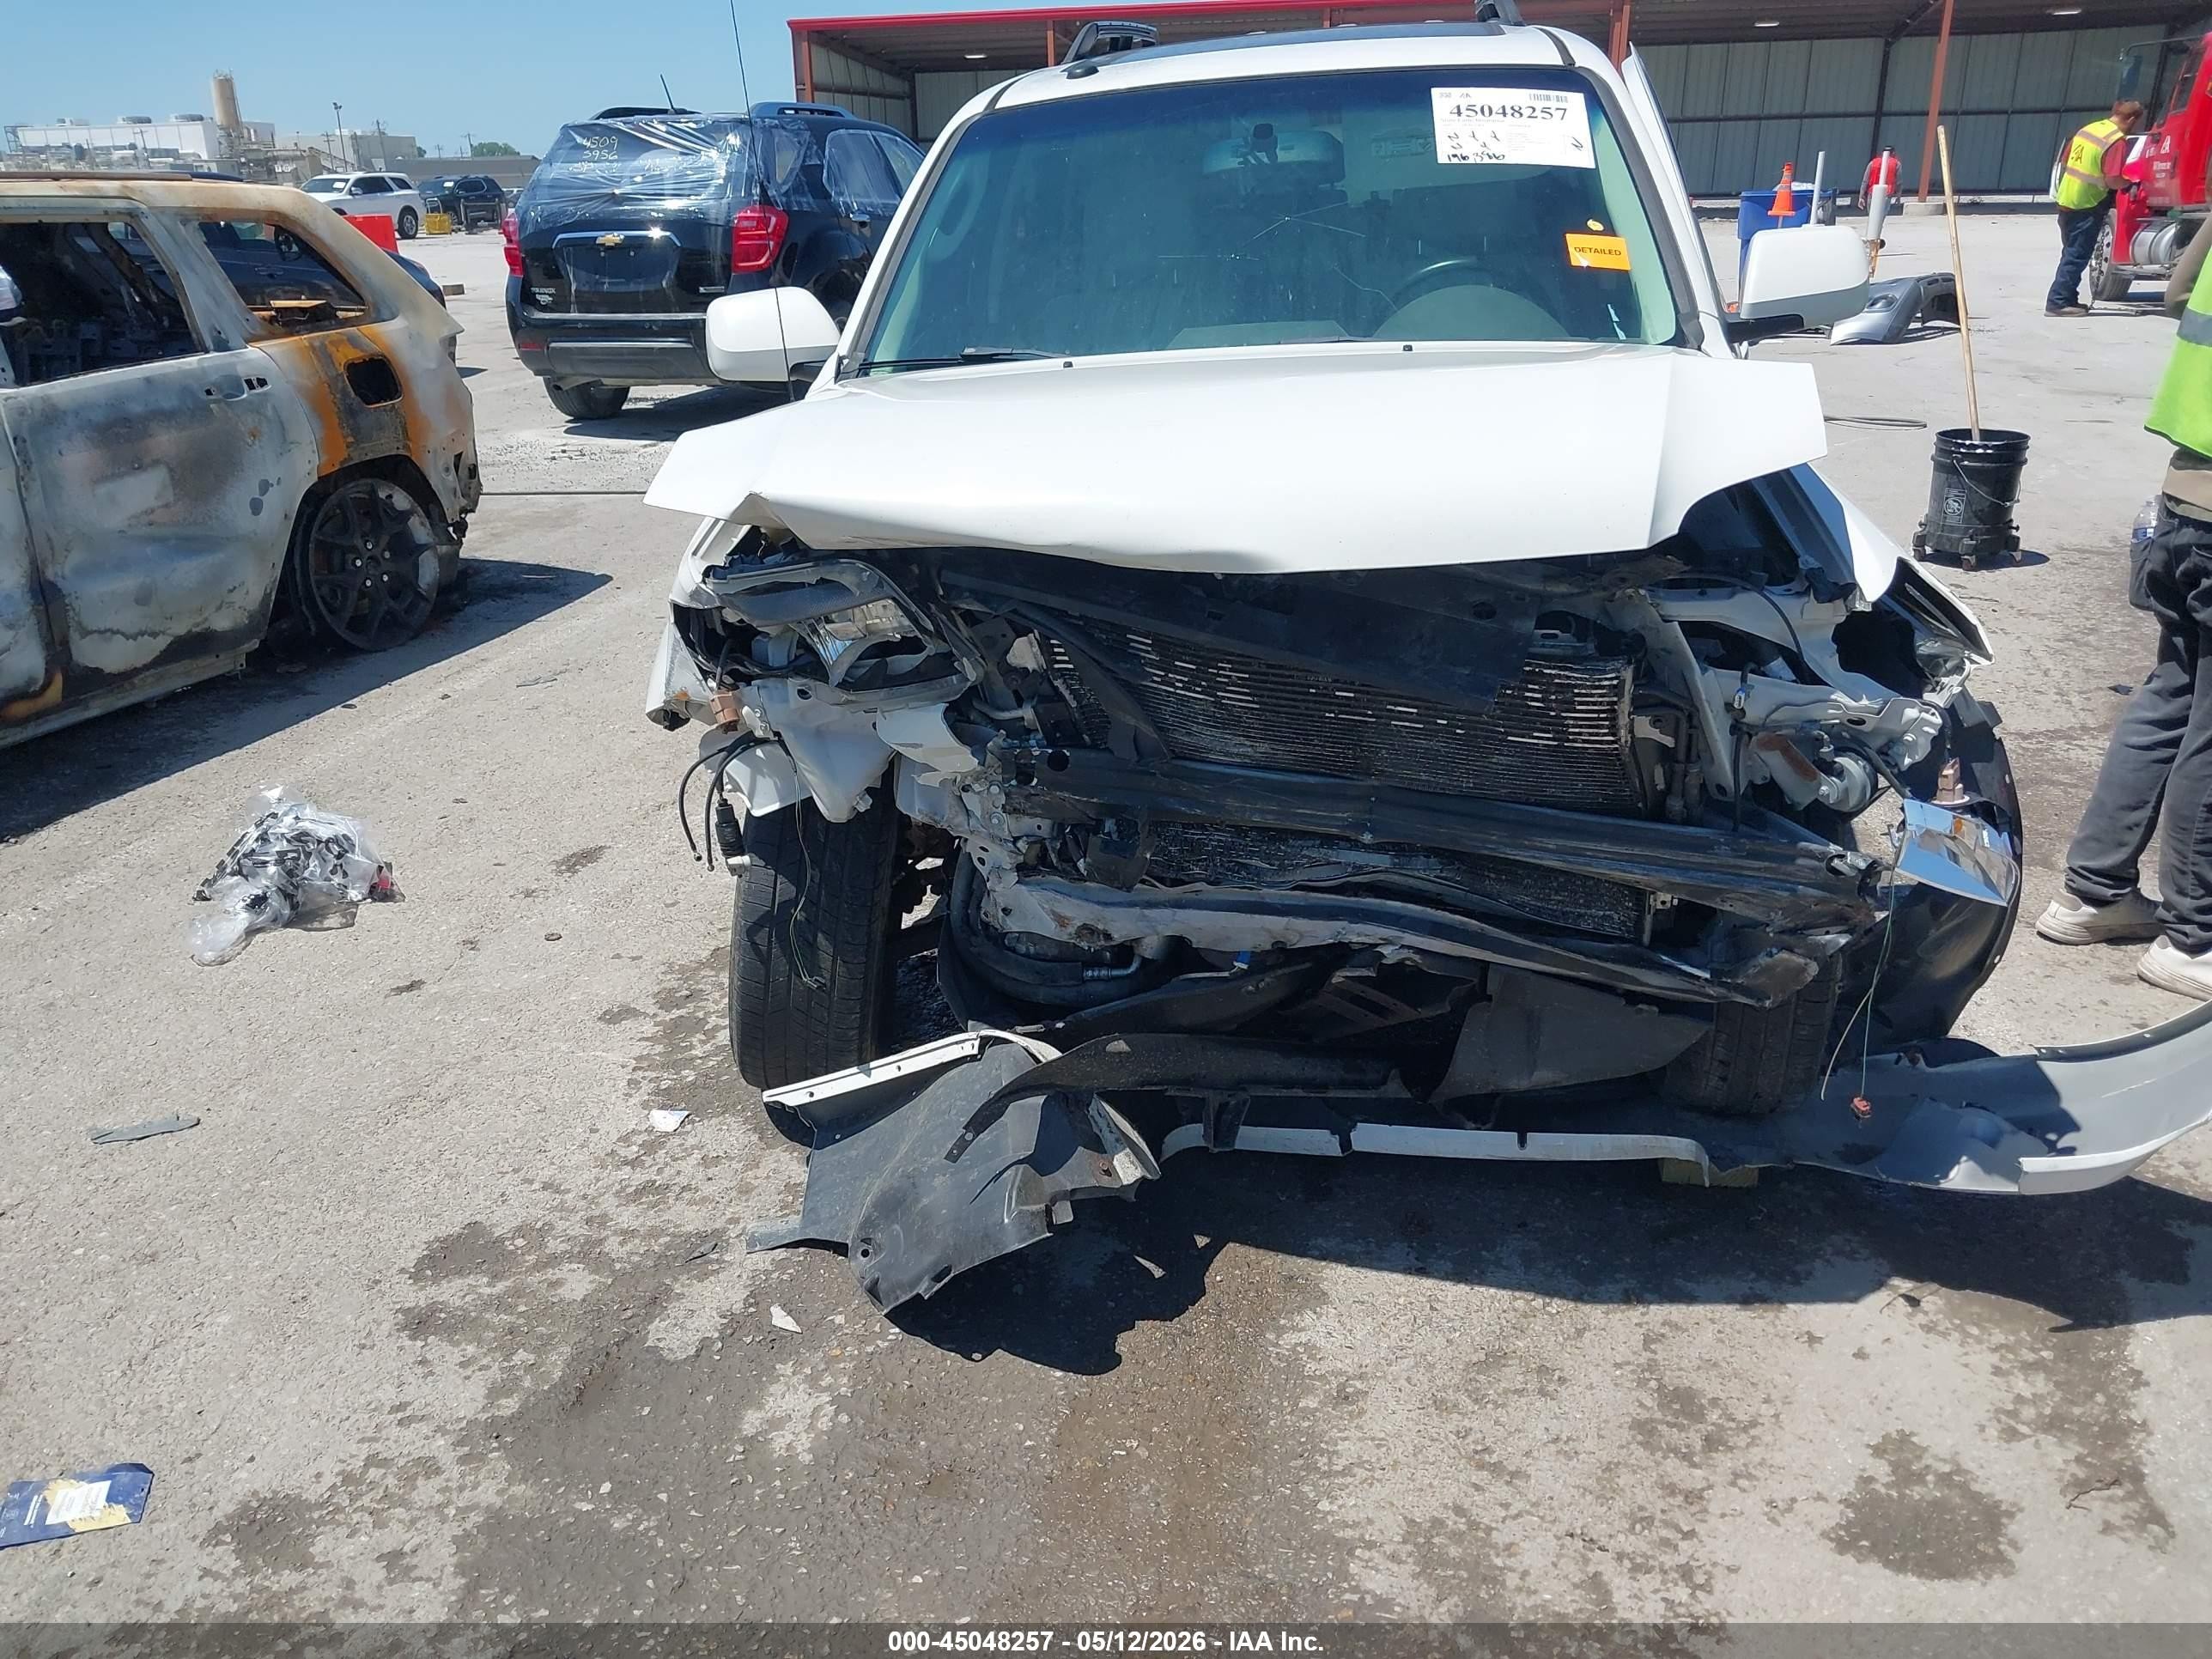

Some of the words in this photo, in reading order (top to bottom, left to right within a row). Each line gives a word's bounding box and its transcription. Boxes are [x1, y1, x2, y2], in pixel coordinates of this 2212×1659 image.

[1449, 103, 1568, 121] 45048257
[582, 136, 619, 150] 4509
[1573, 246, 1622, 256] DETAILED
